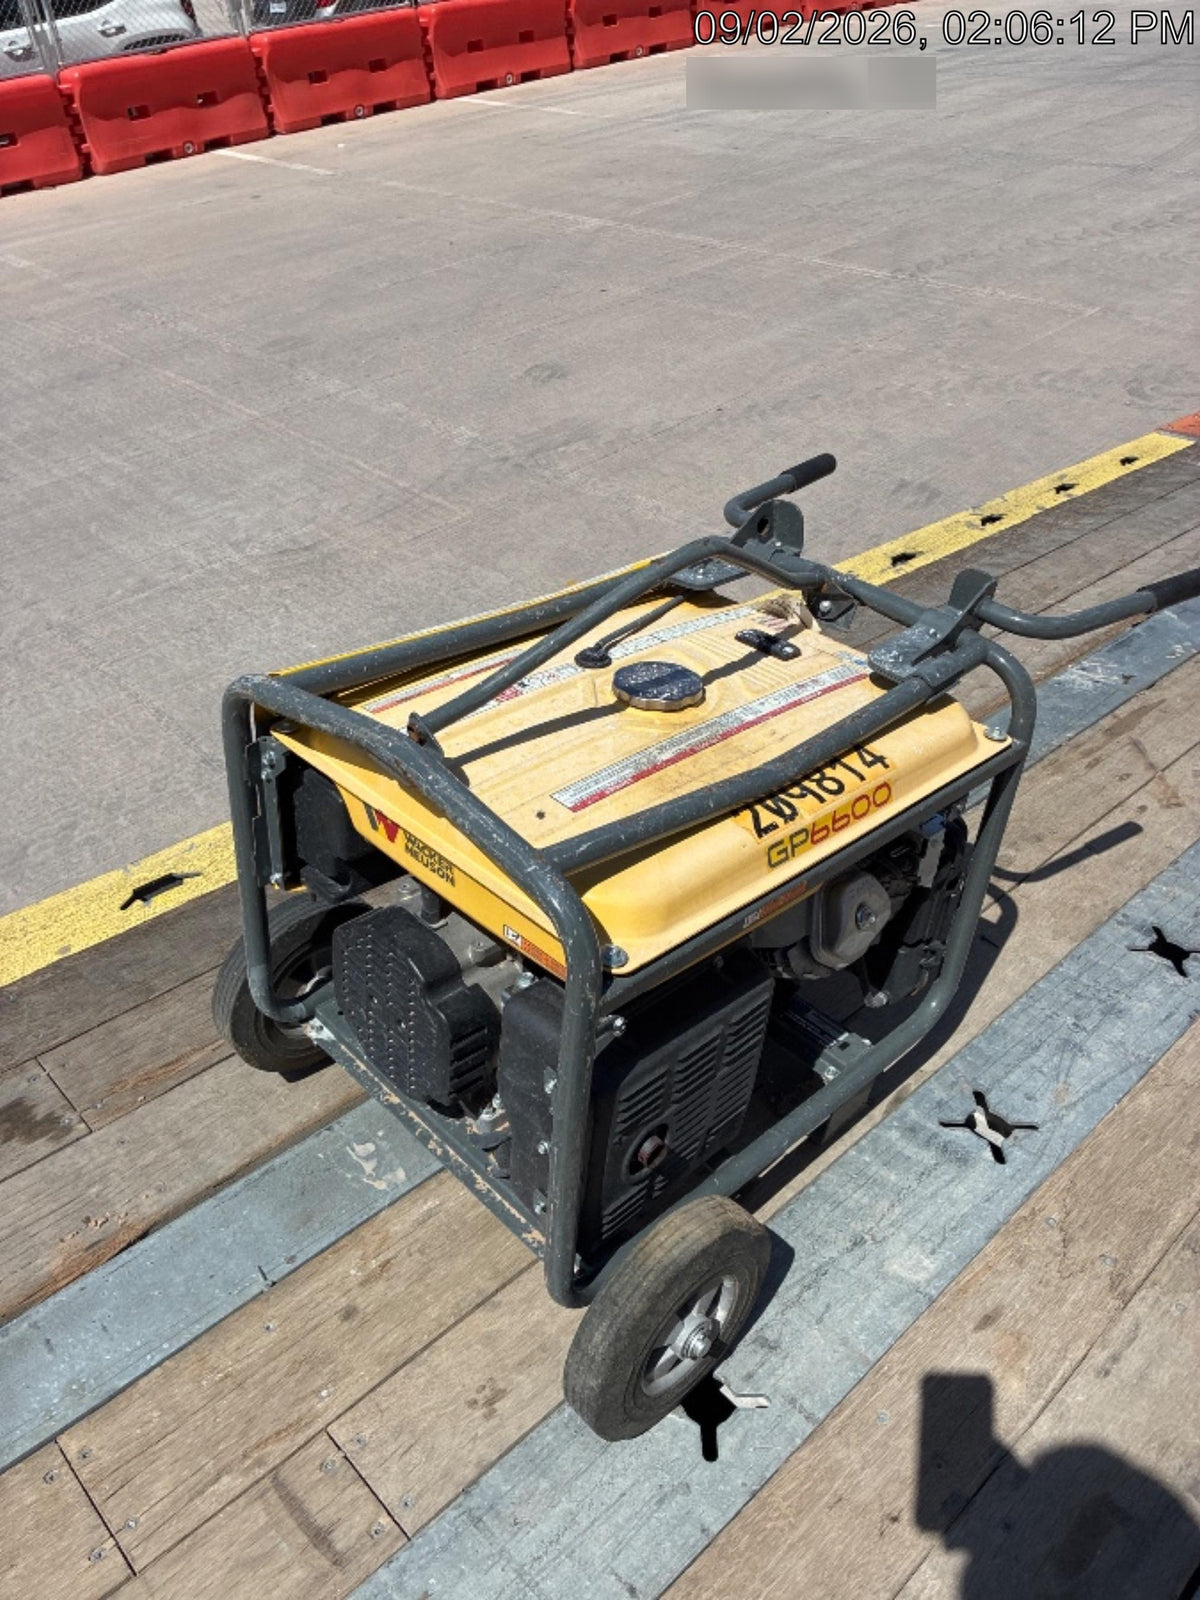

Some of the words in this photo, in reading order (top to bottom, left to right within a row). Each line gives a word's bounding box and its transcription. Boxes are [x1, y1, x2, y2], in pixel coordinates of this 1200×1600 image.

[768, 781, 892, 869] GP6600
[403, 829, 455, 875] WACKER
[405, 841, 456, 888] NEUSON
